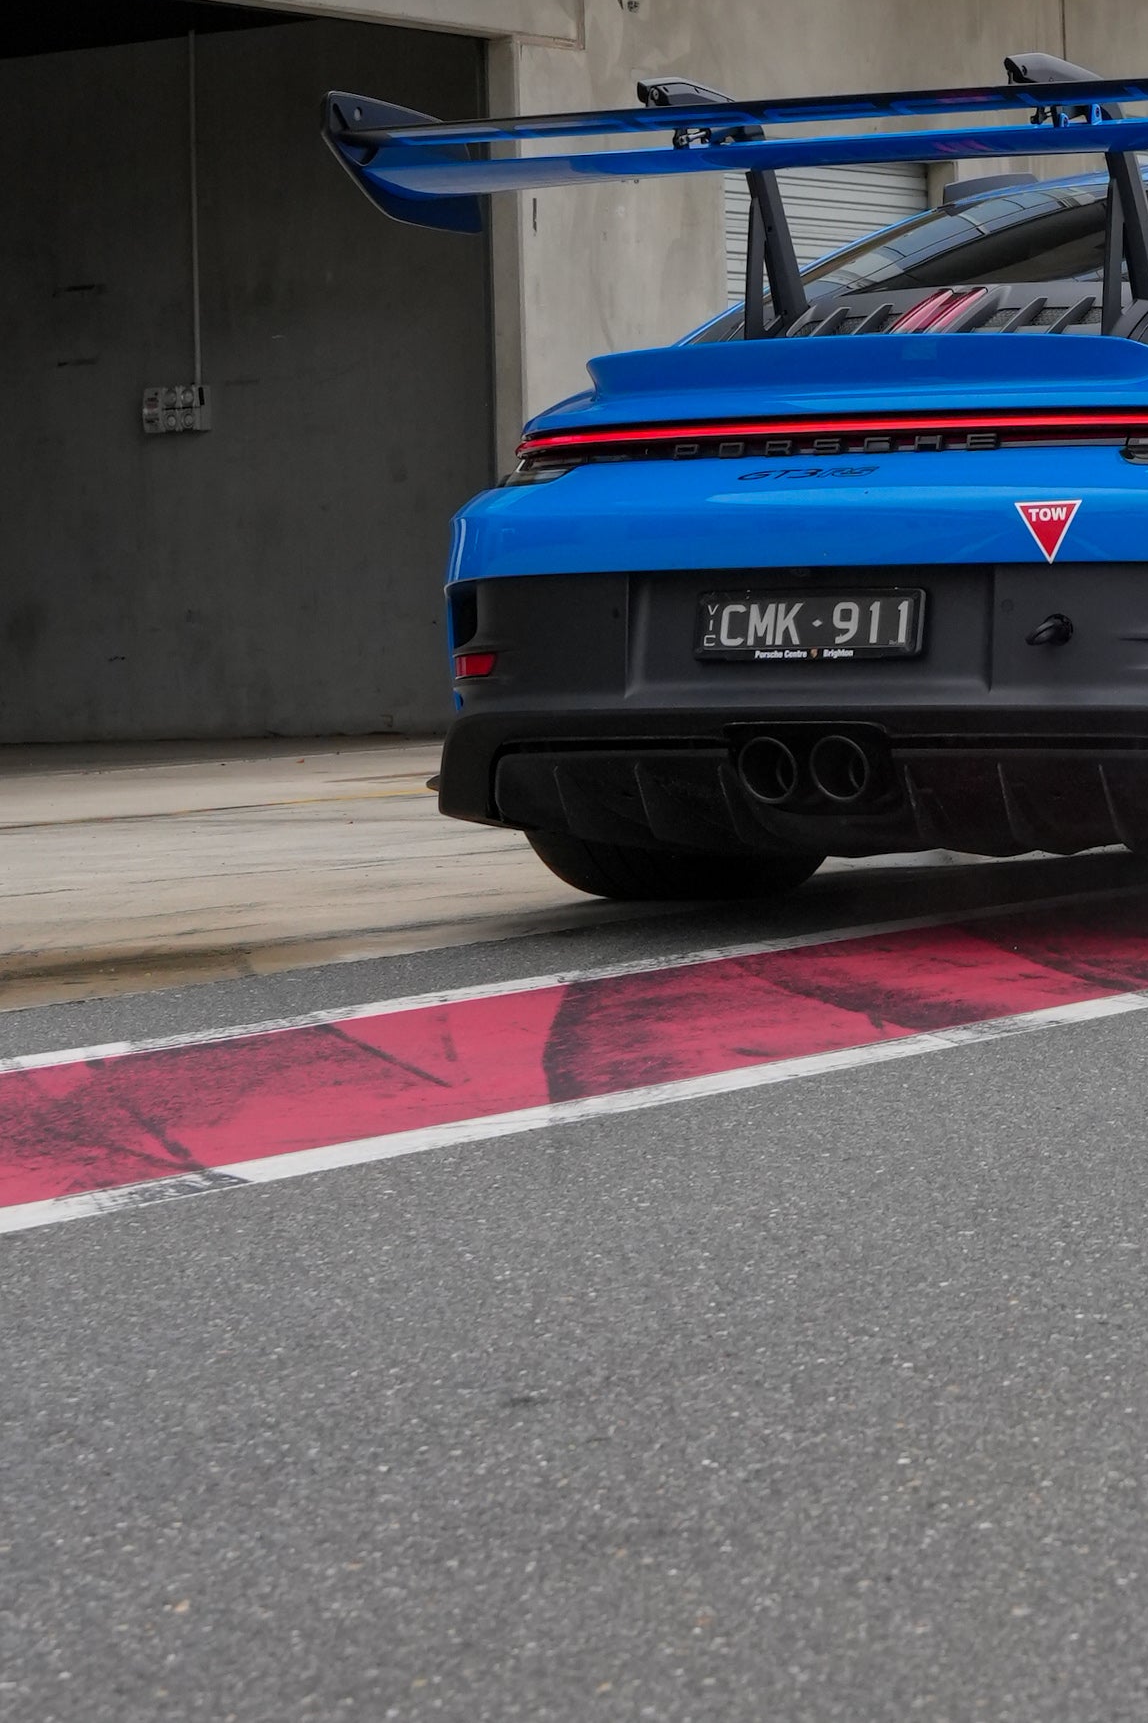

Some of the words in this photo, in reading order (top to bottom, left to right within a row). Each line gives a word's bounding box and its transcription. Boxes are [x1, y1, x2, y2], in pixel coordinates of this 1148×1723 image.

[674, 433, 997, 460] PORSCHE
[1028, 507, 1067, 522] TOW
[755, 650, 783, 659] Porsche
[784, 650, 808, 658] Centre
[823, 649, 854, 659] Brighton
